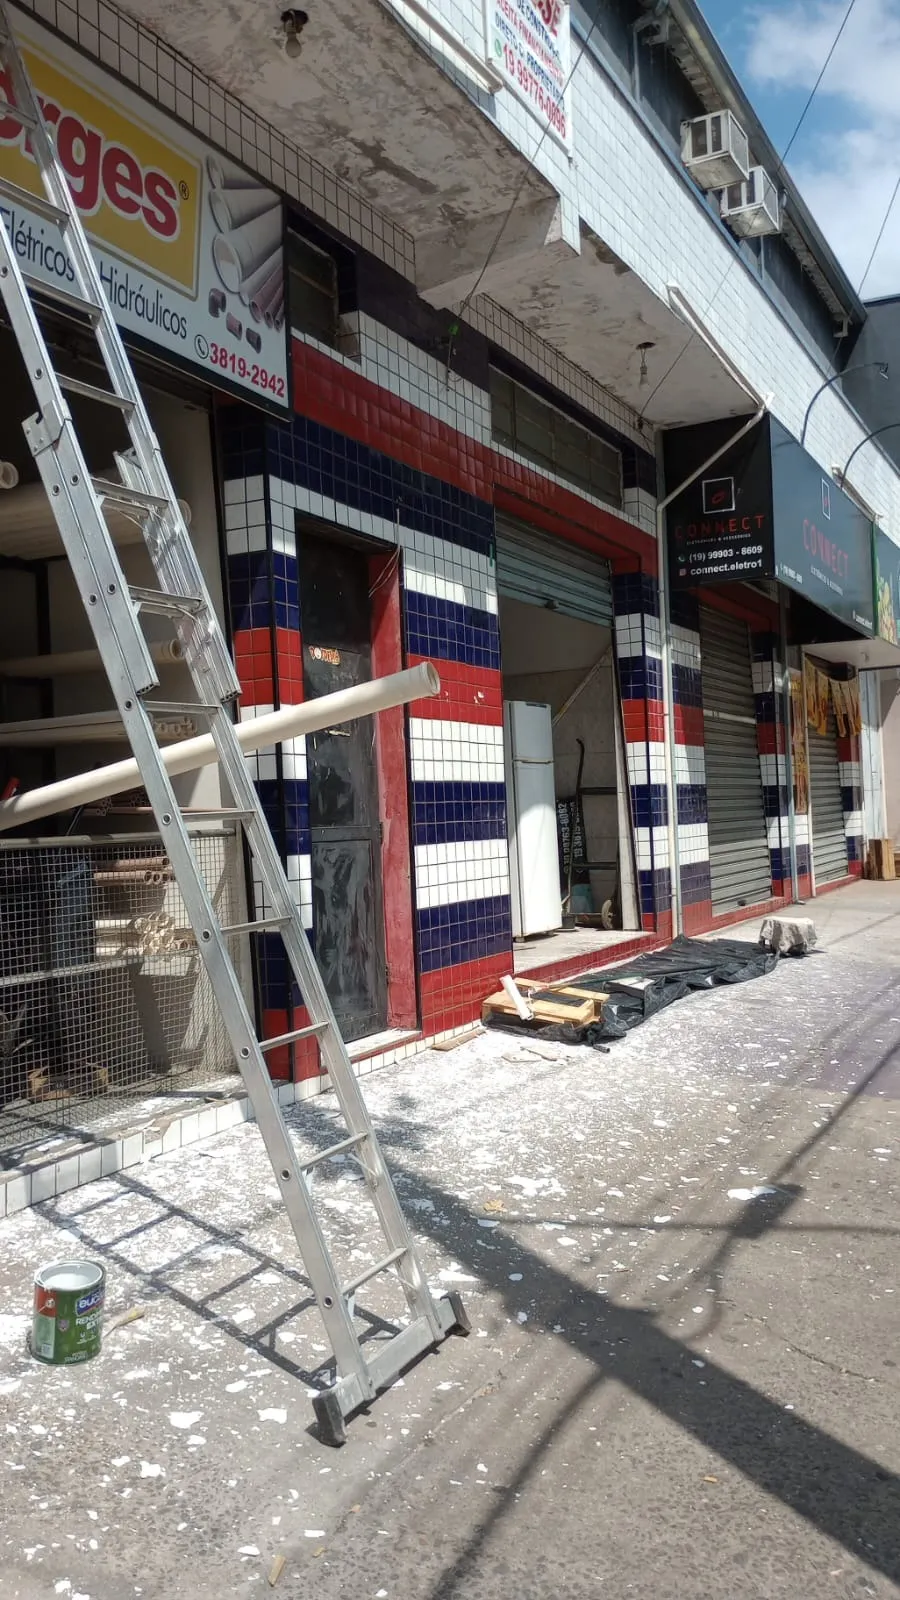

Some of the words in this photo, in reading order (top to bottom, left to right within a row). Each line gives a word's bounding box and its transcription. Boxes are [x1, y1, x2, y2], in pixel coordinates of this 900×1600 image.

[503, 43, 515, 77] 19
[100, 261, 187, 340] Hidráulicos
[210, 342, 285, 398] 3819-2942
[675, 514, 765, 539] CONNECT
[689, 552, 706, 564] (19)
[803, 519, 849, 579] CONNECT
[690, 559, 762, 576] connect.eletro1
